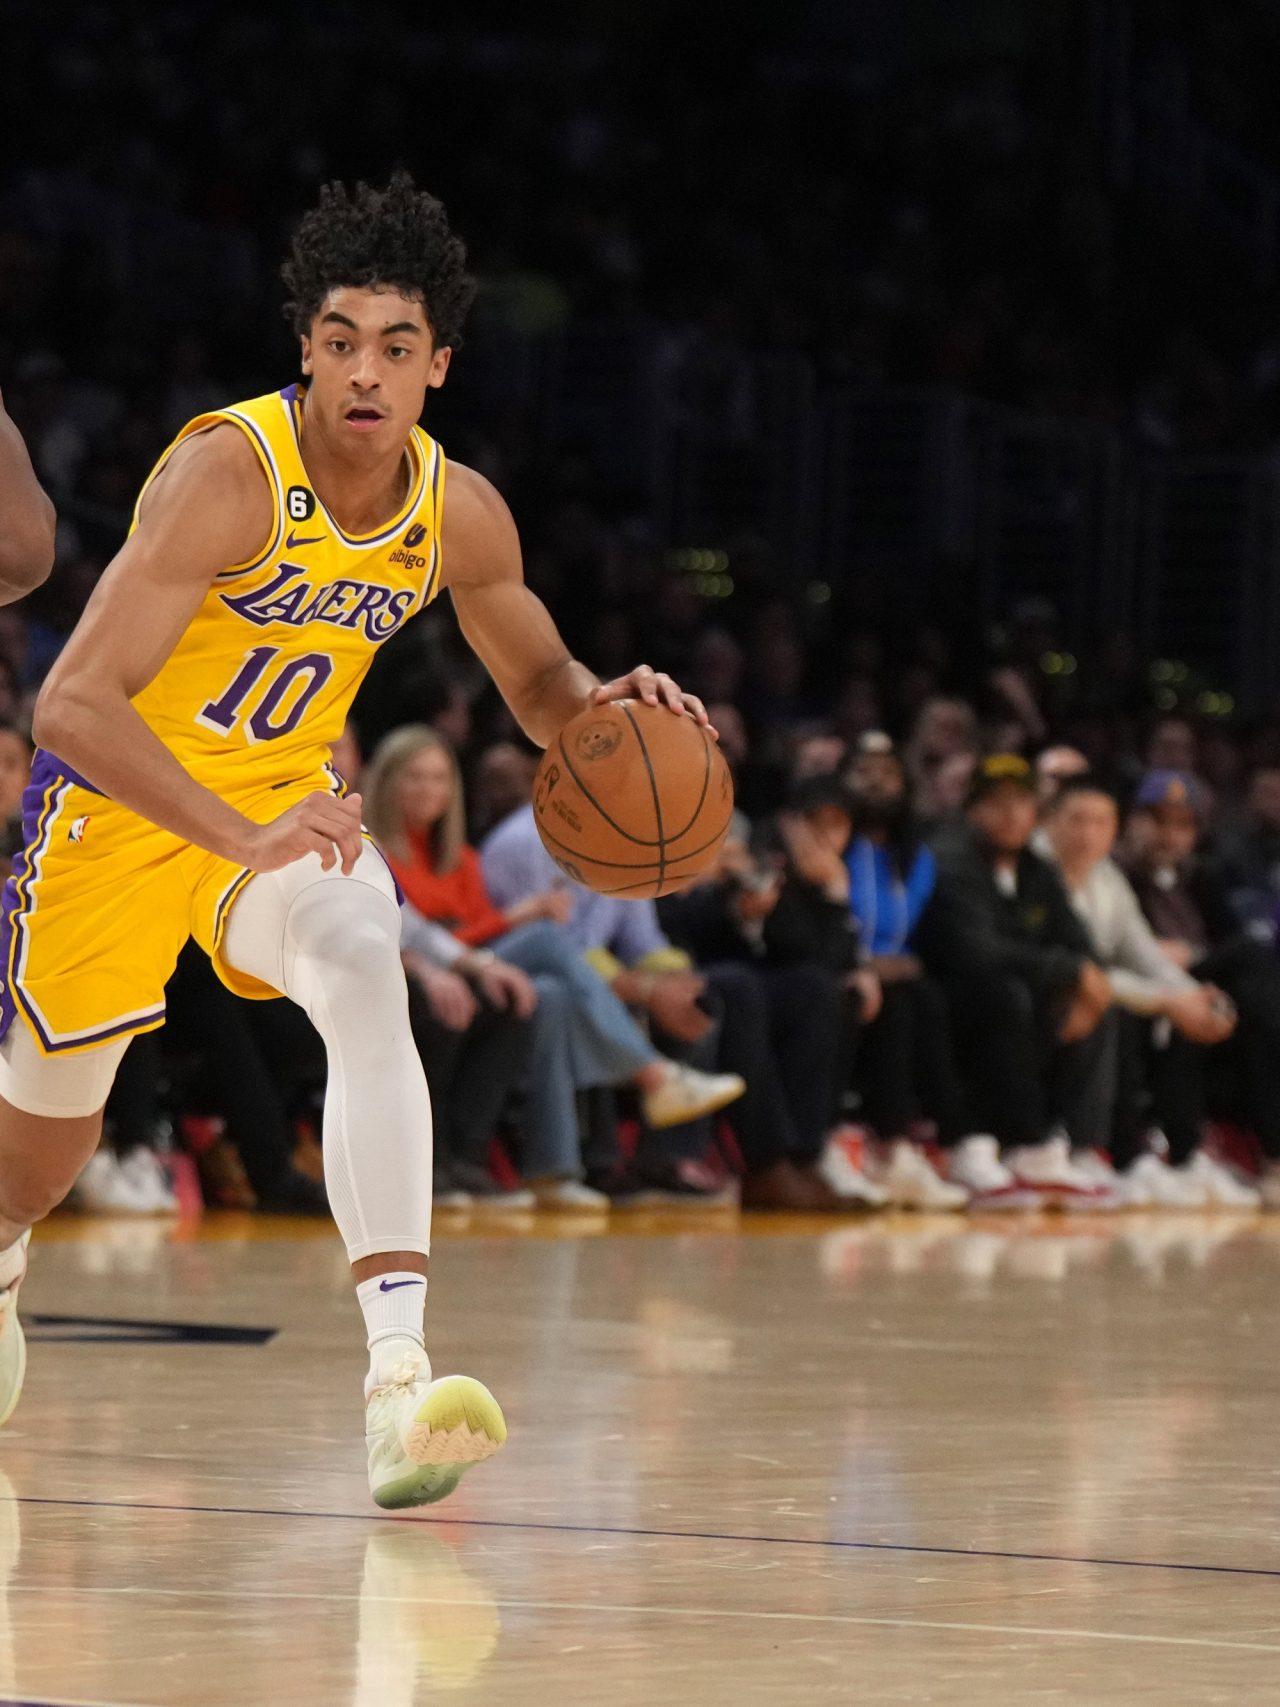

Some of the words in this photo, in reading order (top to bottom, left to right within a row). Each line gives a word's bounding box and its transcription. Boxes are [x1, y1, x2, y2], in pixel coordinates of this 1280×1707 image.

[290, 491, 307, 518] 6
[388, 550, 426, 570] bibigo
[219, 562, 416, 642] LAKERS
[195, 646, 334, 746] 10
